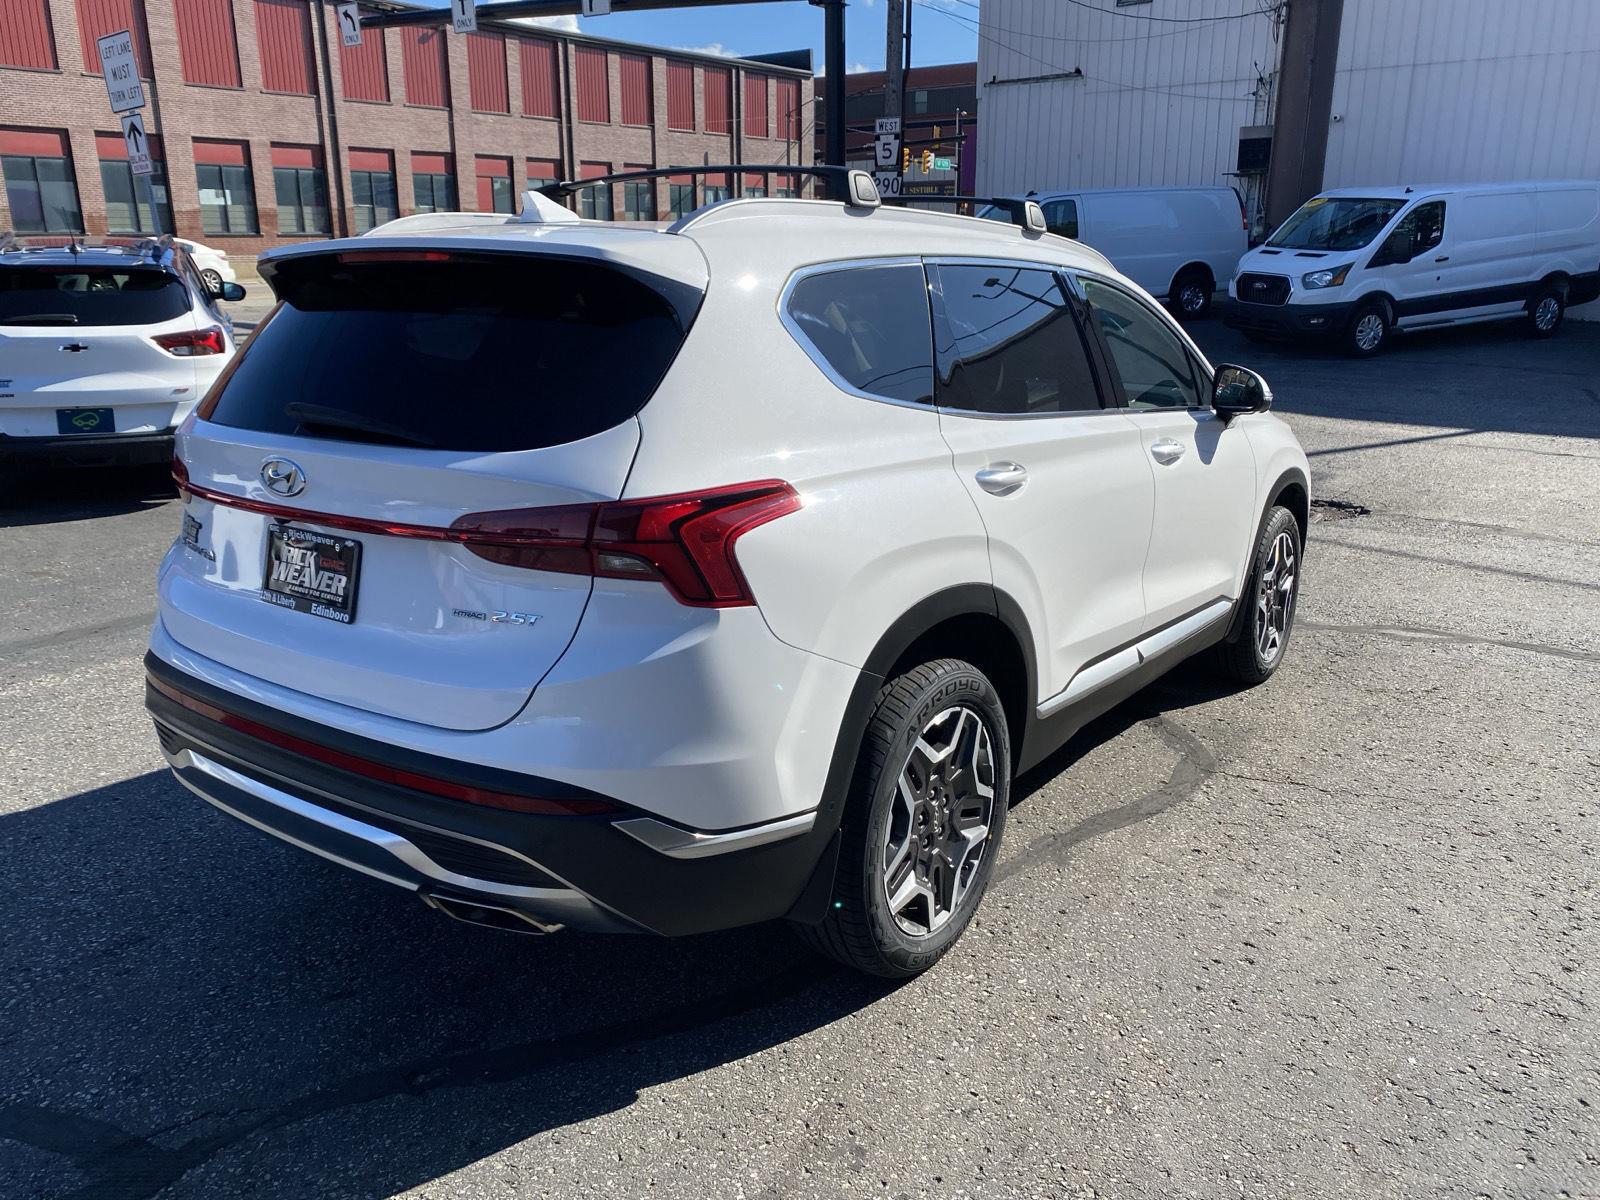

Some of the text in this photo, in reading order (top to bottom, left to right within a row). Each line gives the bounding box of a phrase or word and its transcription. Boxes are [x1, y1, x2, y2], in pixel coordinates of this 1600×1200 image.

[456, 17, 473, 28] ONLY
[344, 34, 359, 44] ONLY
[102, 41, 132, 60] LEFT LANE
[111, 63, 131, 81] MUST
[110, 86, 141, 103] TURN LEFT
[878, 121, 898, 131] WEST
[882, 142, 892, 159] 5
[288, 529, 334, 546] RickWeaver
[283, 544, 318, 568] RICK
[270, 560, 348, 596] WEAVER
[310, 603, 349, 622] Edinboro
[906, 678, 981, 746] ARROYO
